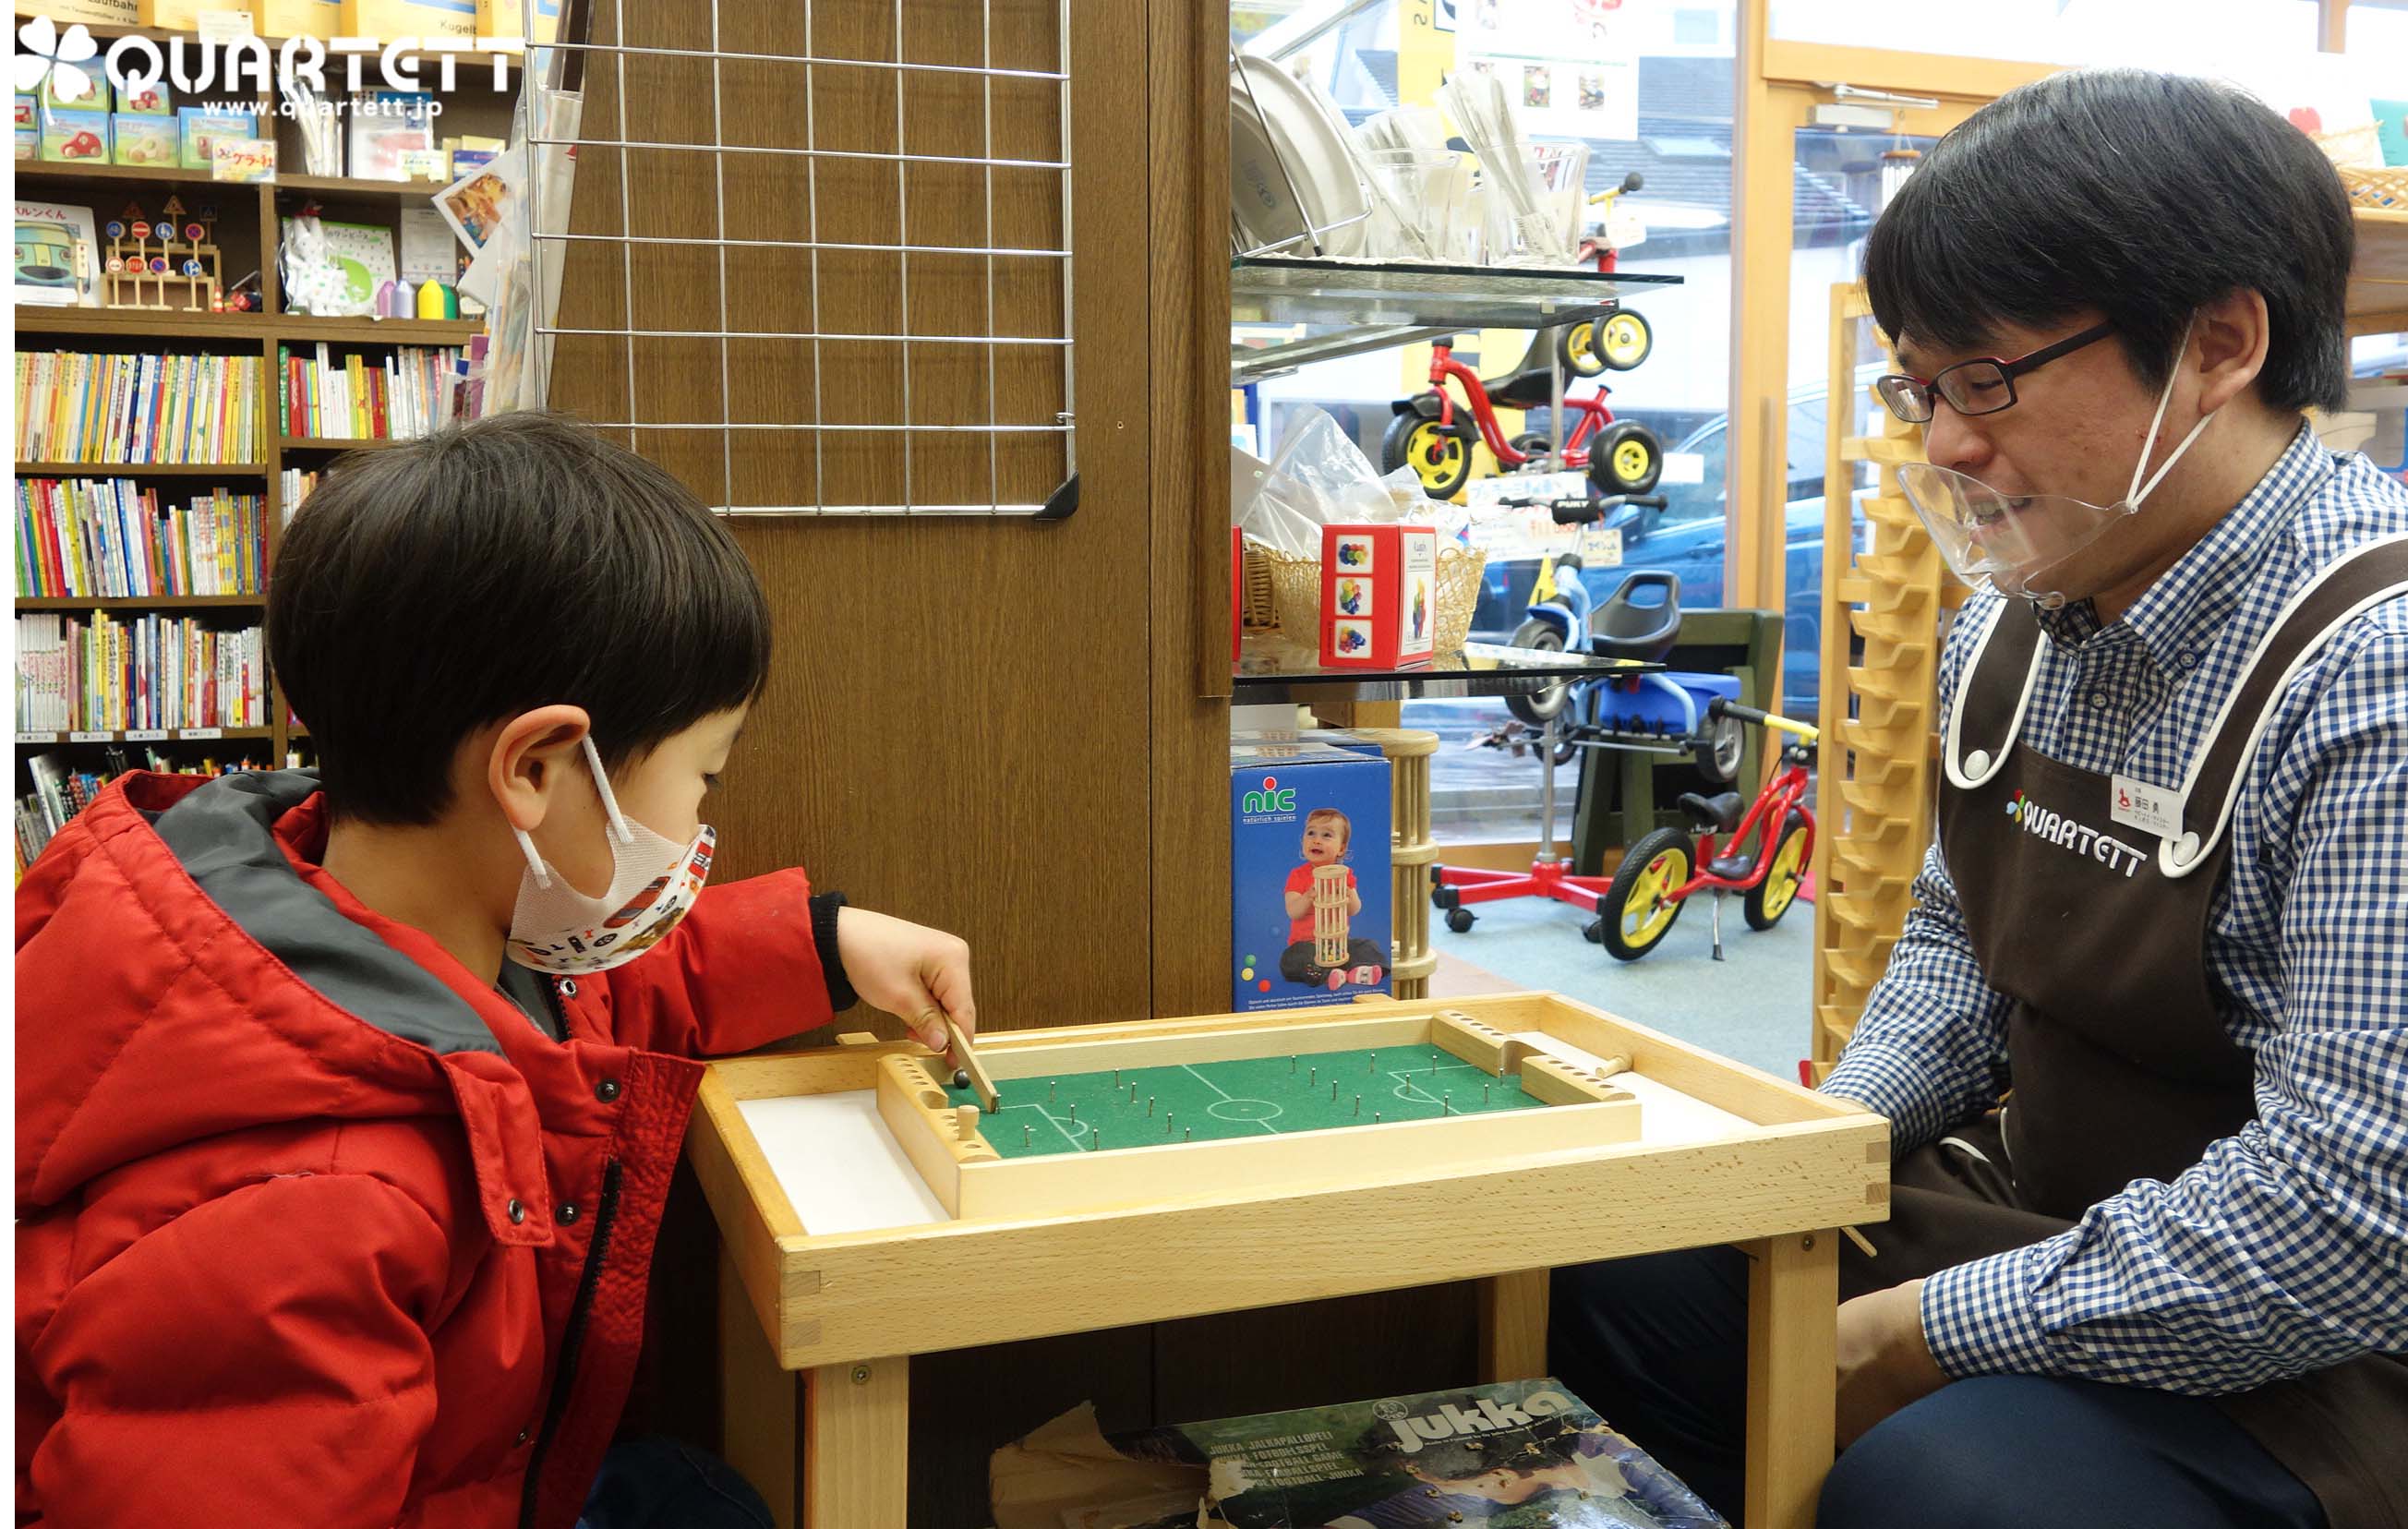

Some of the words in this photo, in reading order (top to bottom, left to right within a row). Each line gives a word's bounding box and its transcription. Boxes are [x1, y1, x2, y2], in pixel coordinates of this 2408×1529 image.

[1557, 500, 1590, 509] PUKY
[1243, 776, 1296, 813] nic
[2023, 800, 2149, 877] QUARTETT
[1388, 1390, 1575, 1454] jukka
